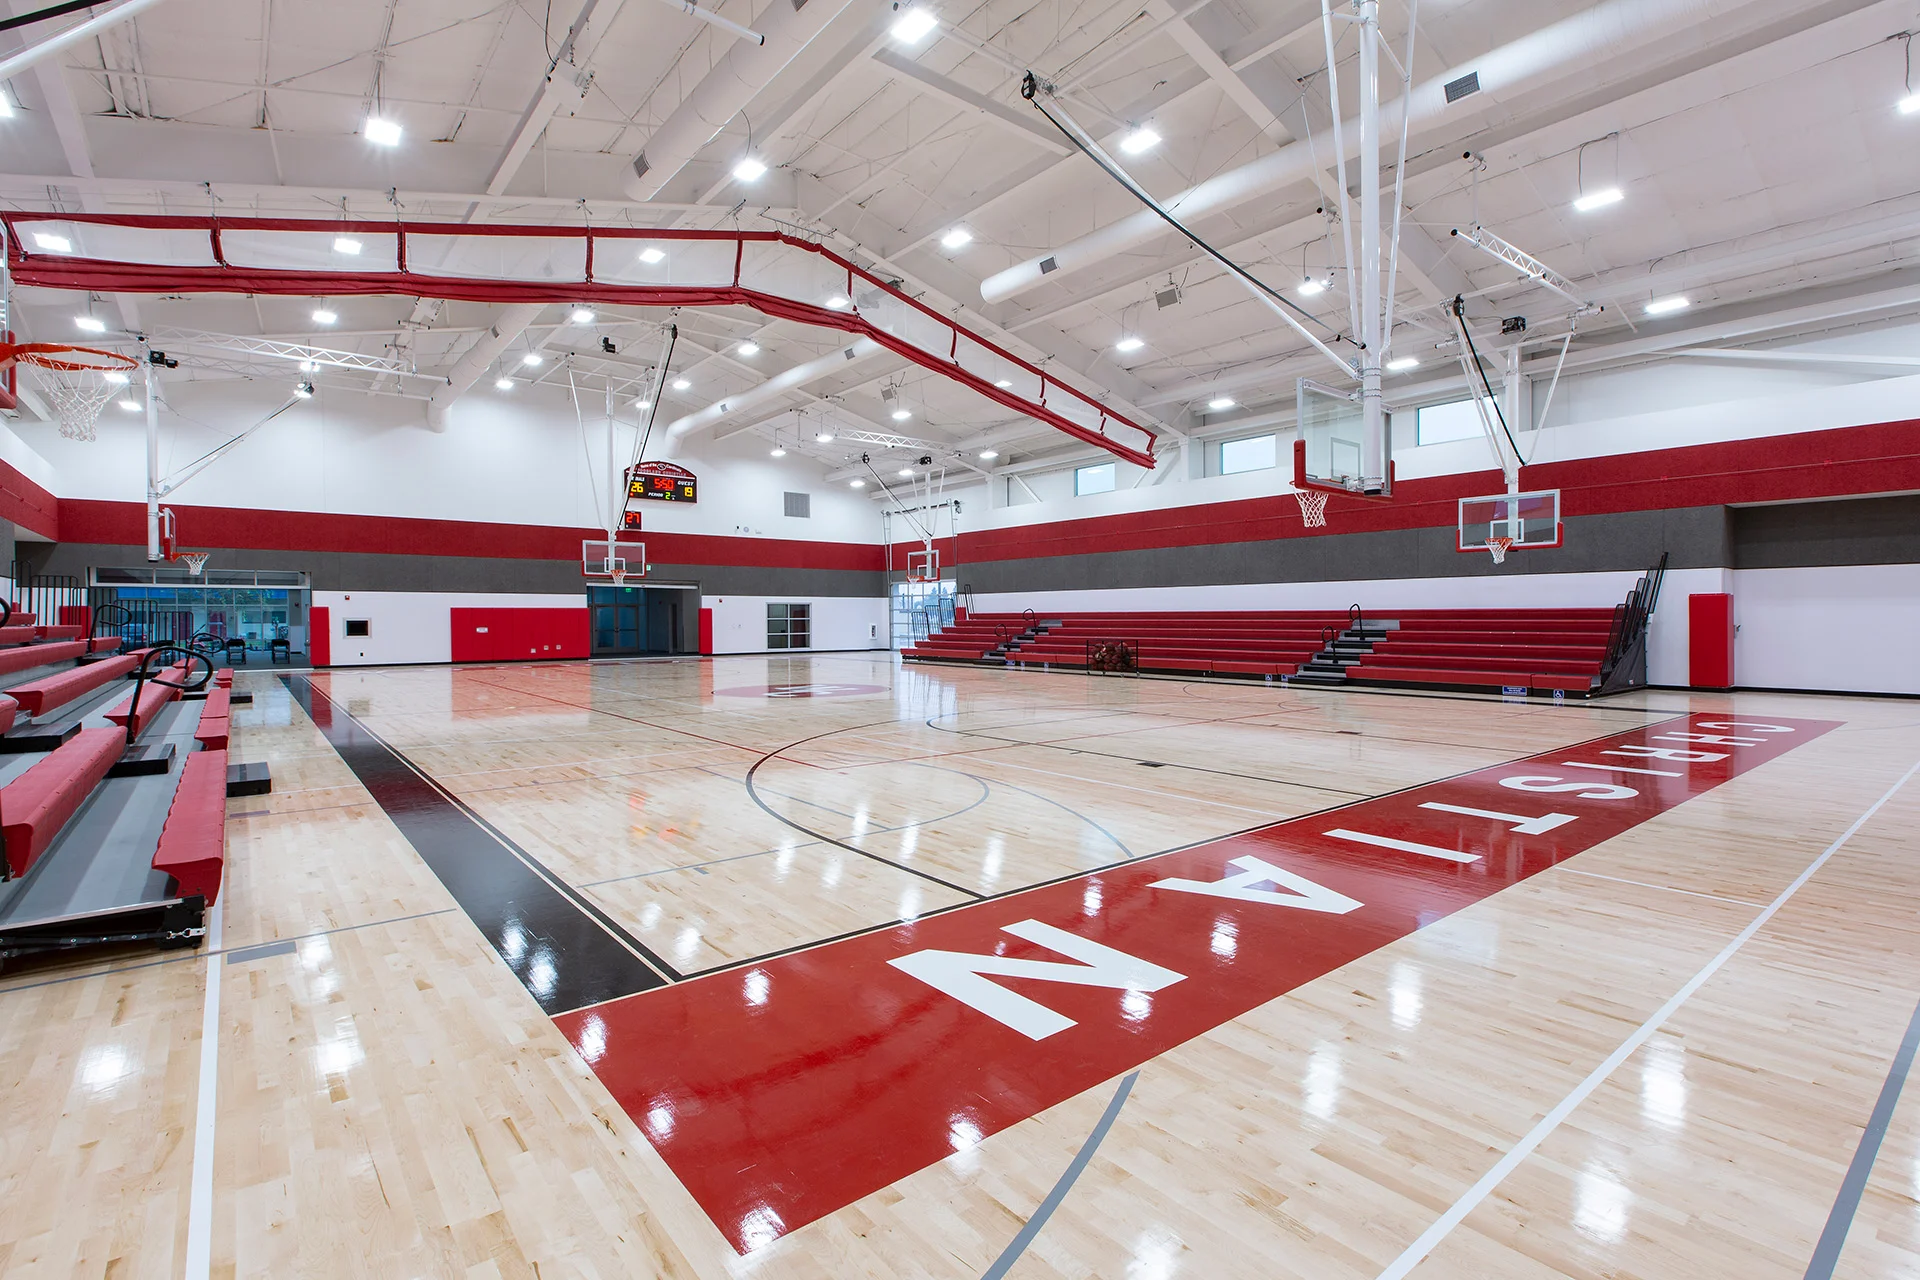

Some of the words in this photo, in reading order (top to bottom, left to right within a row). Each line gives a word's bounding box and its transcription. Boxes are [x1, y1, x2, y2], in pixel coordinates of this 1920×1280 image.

[630, 481, 644, 493] 26
[654, 477, 675, 490] 5:50
[665, 491, 671, 500] 2
[684, 486, 693, 497] 19
[626, 512, 640, 524] 27
[886, 721, 1795, 1041] CHRISTIAN
